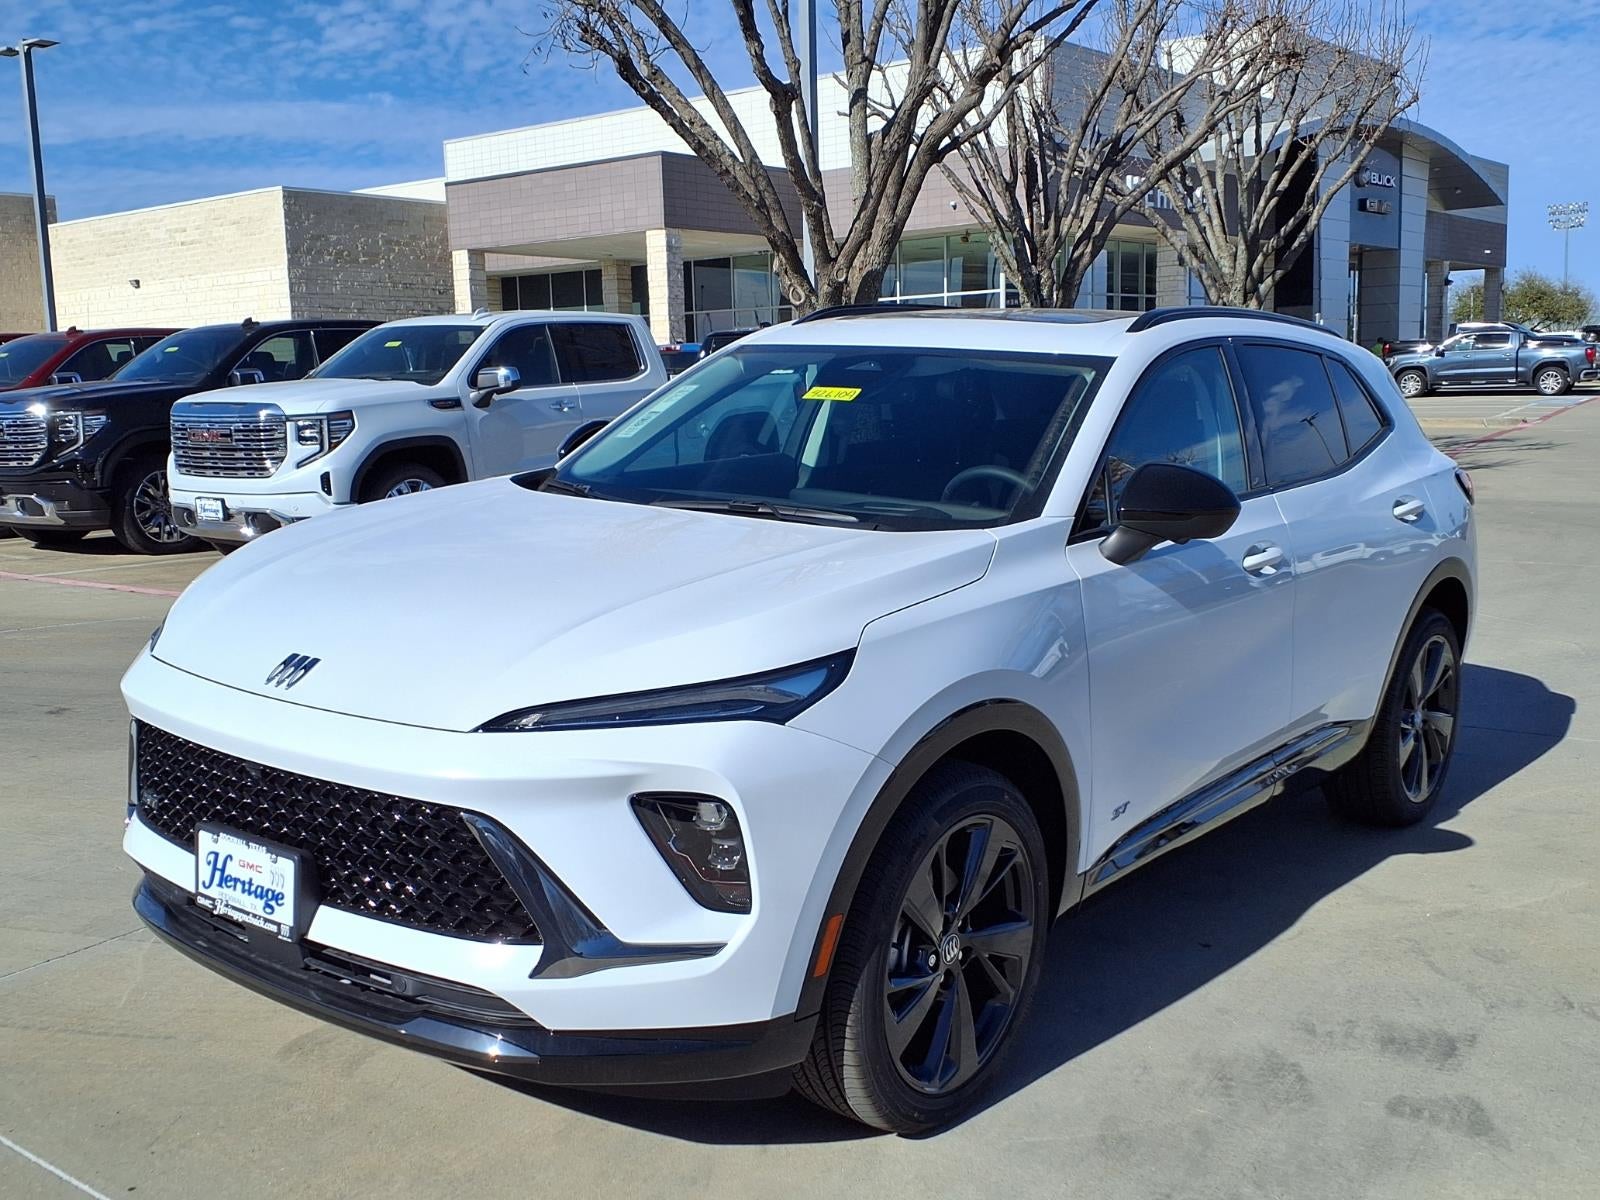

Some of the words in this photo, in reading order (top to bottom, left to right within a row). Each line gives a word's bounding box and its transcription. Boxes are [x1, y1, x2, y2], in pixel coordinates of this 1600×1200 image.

[1371, 172, 1396, 187] BUICK
[189, 428, 231, 443] GMC
[238, 859, 263, 874] GMC
[202, 850, 285, 916] Heritage
